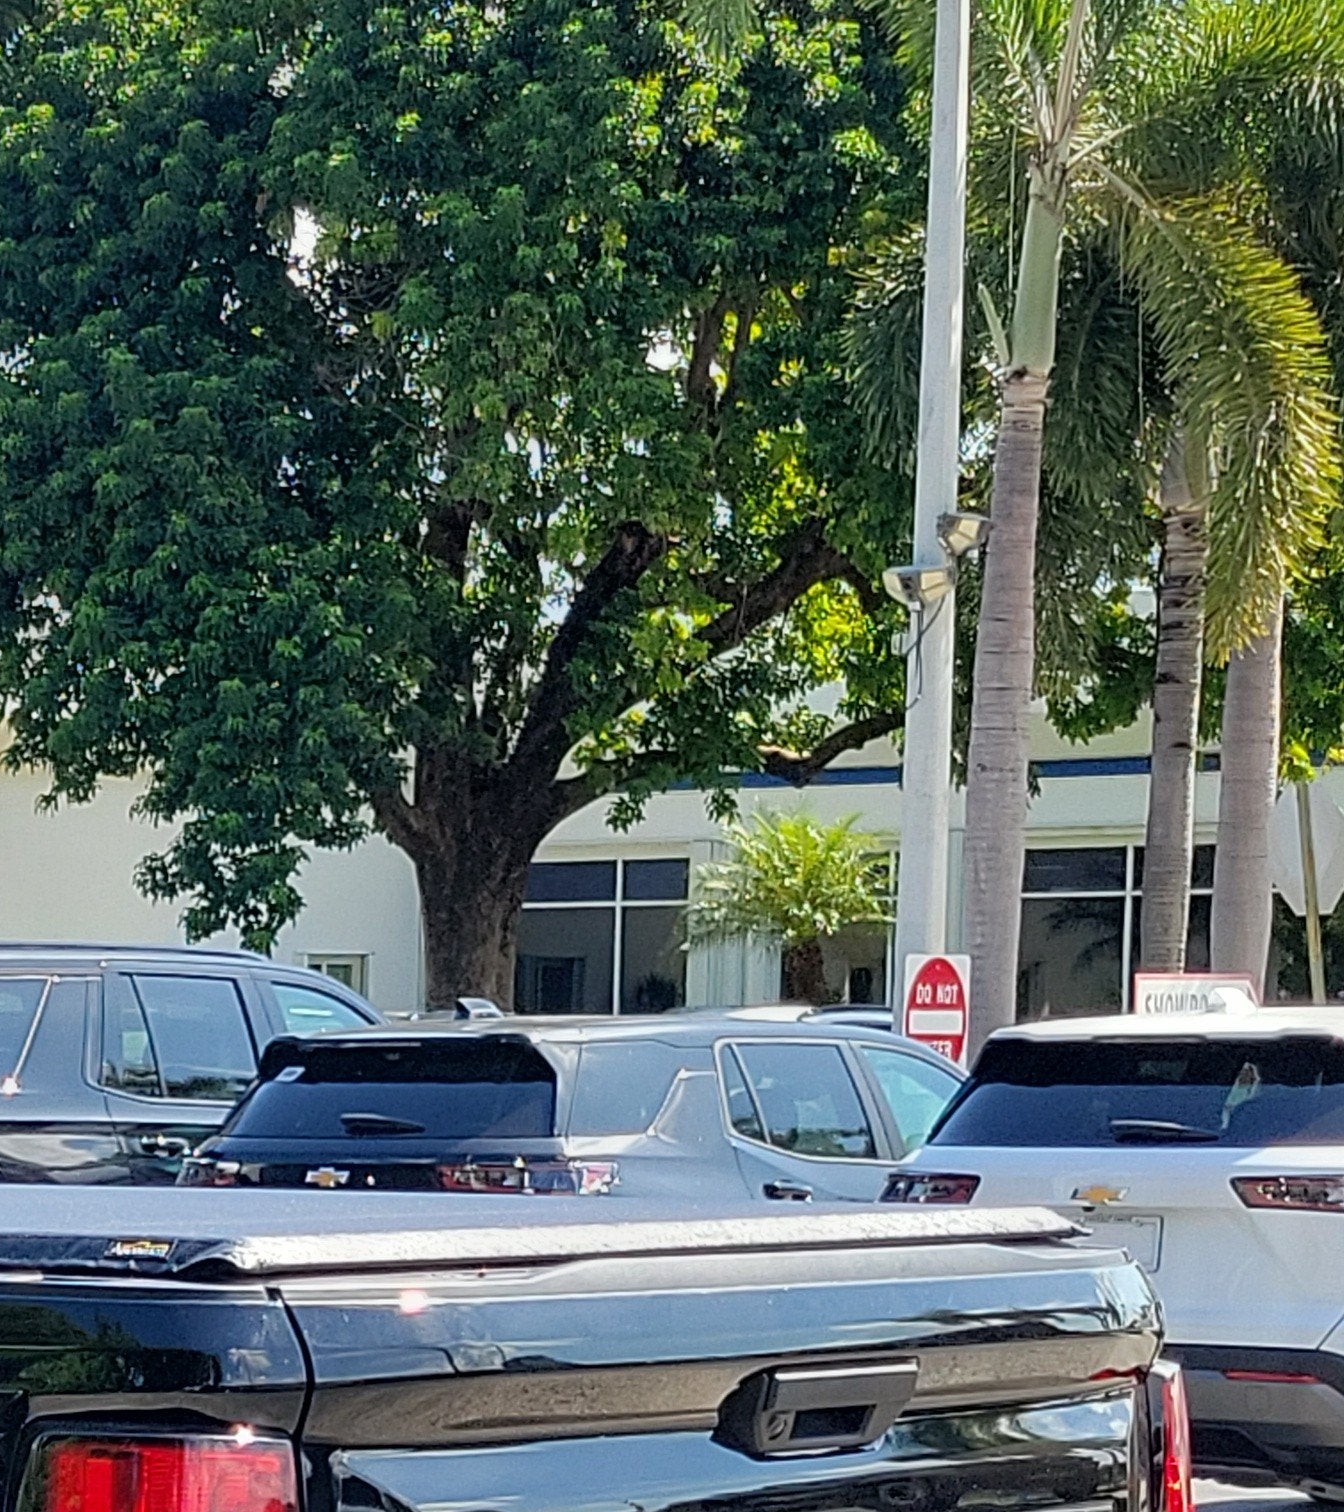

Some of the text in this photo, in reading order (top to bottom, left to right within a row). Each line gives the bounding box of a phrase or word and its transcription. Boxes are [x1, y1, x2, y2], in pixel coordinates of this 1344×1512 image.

[915, 983, 958, 1004] DO NOT
[1145, 992, 1209, 1014] SHOWRO
